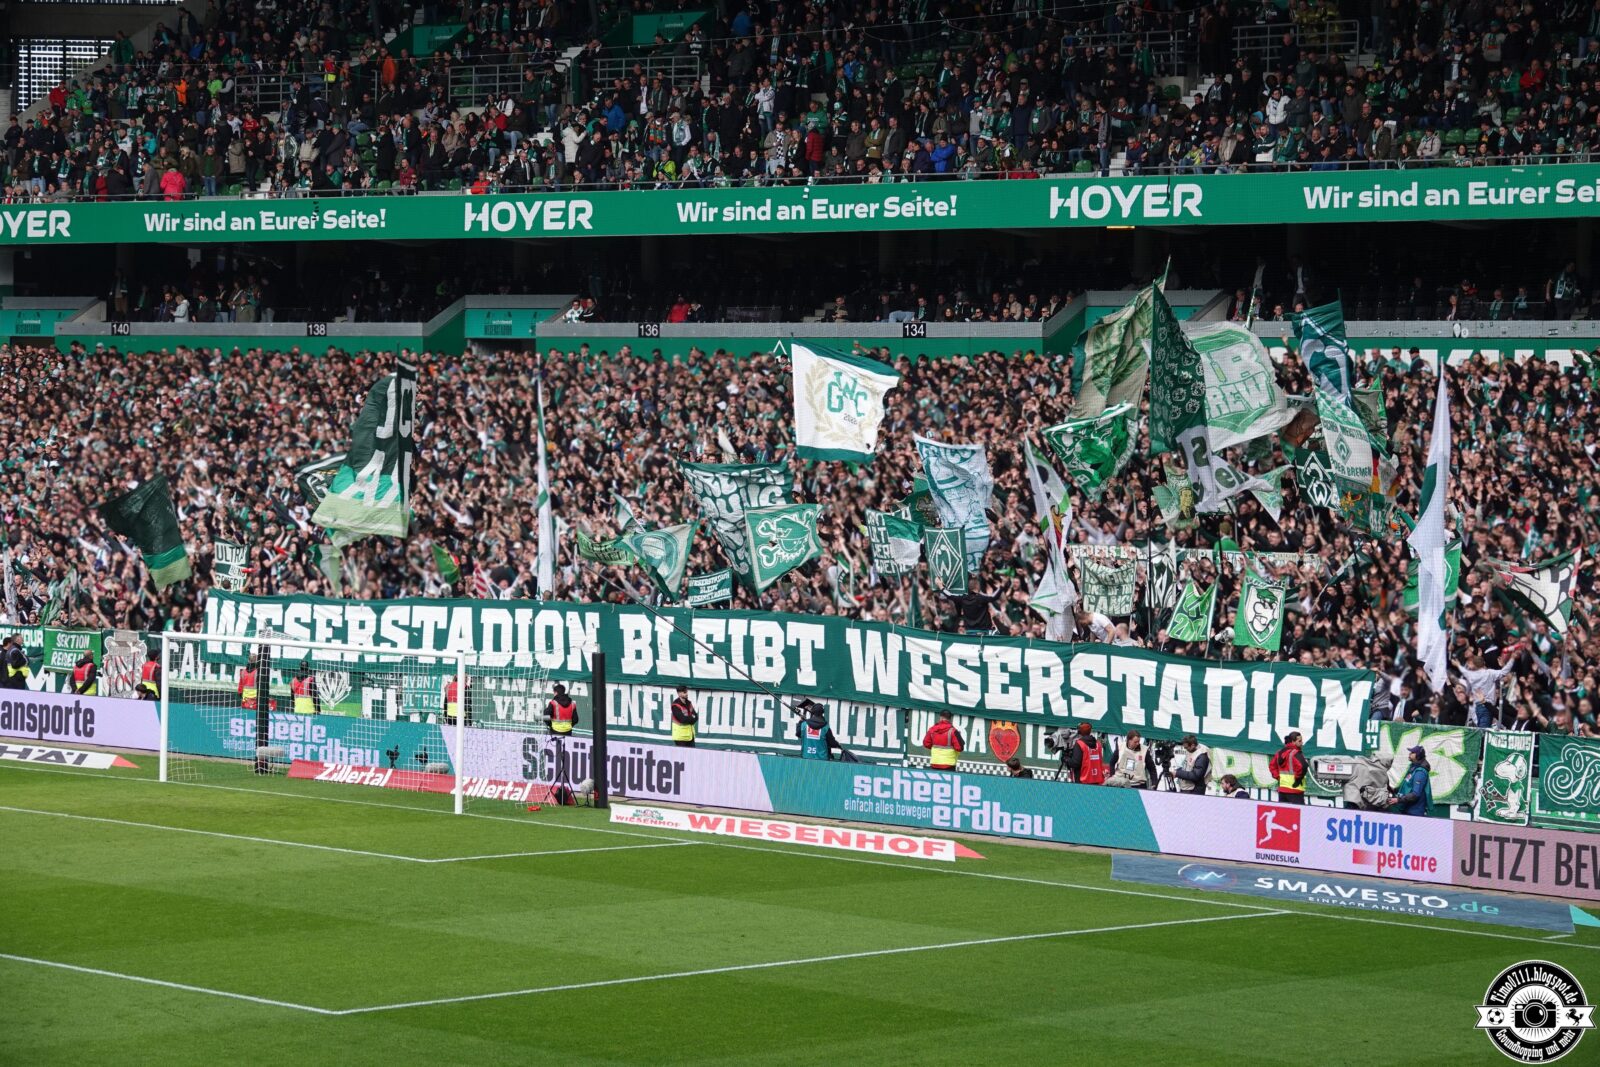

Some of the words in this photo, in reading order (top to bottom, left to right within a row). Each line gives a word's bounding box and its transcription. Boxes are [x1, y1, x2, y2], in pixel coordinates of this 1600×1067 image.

[1050, 184, 1203, 219] HOYER
[1303, 186, 1352, 209] Wir
[1358, 183, 1417, 208] sind
[1424, 188, 1460, 206] an
[1468, 181, 1551, 205] Eurer
[144, 212, 180, 232] Wir
[183, 211, 227, 232] sind
[230, 213, 256, 231] an
[260, 210, 319, 231] Eurer
[322, 208, 386, 229] Seite!
[464, 200, 593, 232] HOYER
[677, 202, 719, 223] Wir
[722, 200, 771, 222] sind
[776, 204, 805, 221] an
[811, 198, 880, 220] Eurer
[883, 195, 957, 218] Seite!
[0, 209, 71, 238] YER
[112, 323, 130, 335] 140
[308, 323, 326, 336] 138
[639, 323, 659, 337] 136
[904, 323, 925, 337] 134
[204, 597, 600, 674] WESERSTADION
[620, 611, 825, 686] BLEIBT
[846, 628, 1370, 752] WESERSTADION
[290, 737, 380, 768] erdbau
[807, 746, 817, 754] 25
[315, 762, 393, 787] Zillertal
[1123, 772, 1135, 780] TV
[853, 769, 982, 807] scheele
[844, 798, 874, 813] einfach
[875, 801, 894, 815] alles
[895, 803, 932, 820] bewegen
[932, 801, 1053, 838] erdbau
[615, 815, 681, 828] WIESENHOF
[687, 814, 947, 857] WIESENHOF
[1326, 814, 1403, 849] saturn
[1255, 852, 1300, 864] BUNDESLIGA
[1377, 849, 1437, 873] petcare
[1460, 833, 1545, 883] JETZT
[1372, 903, 1434, 916] ANLEGEN
